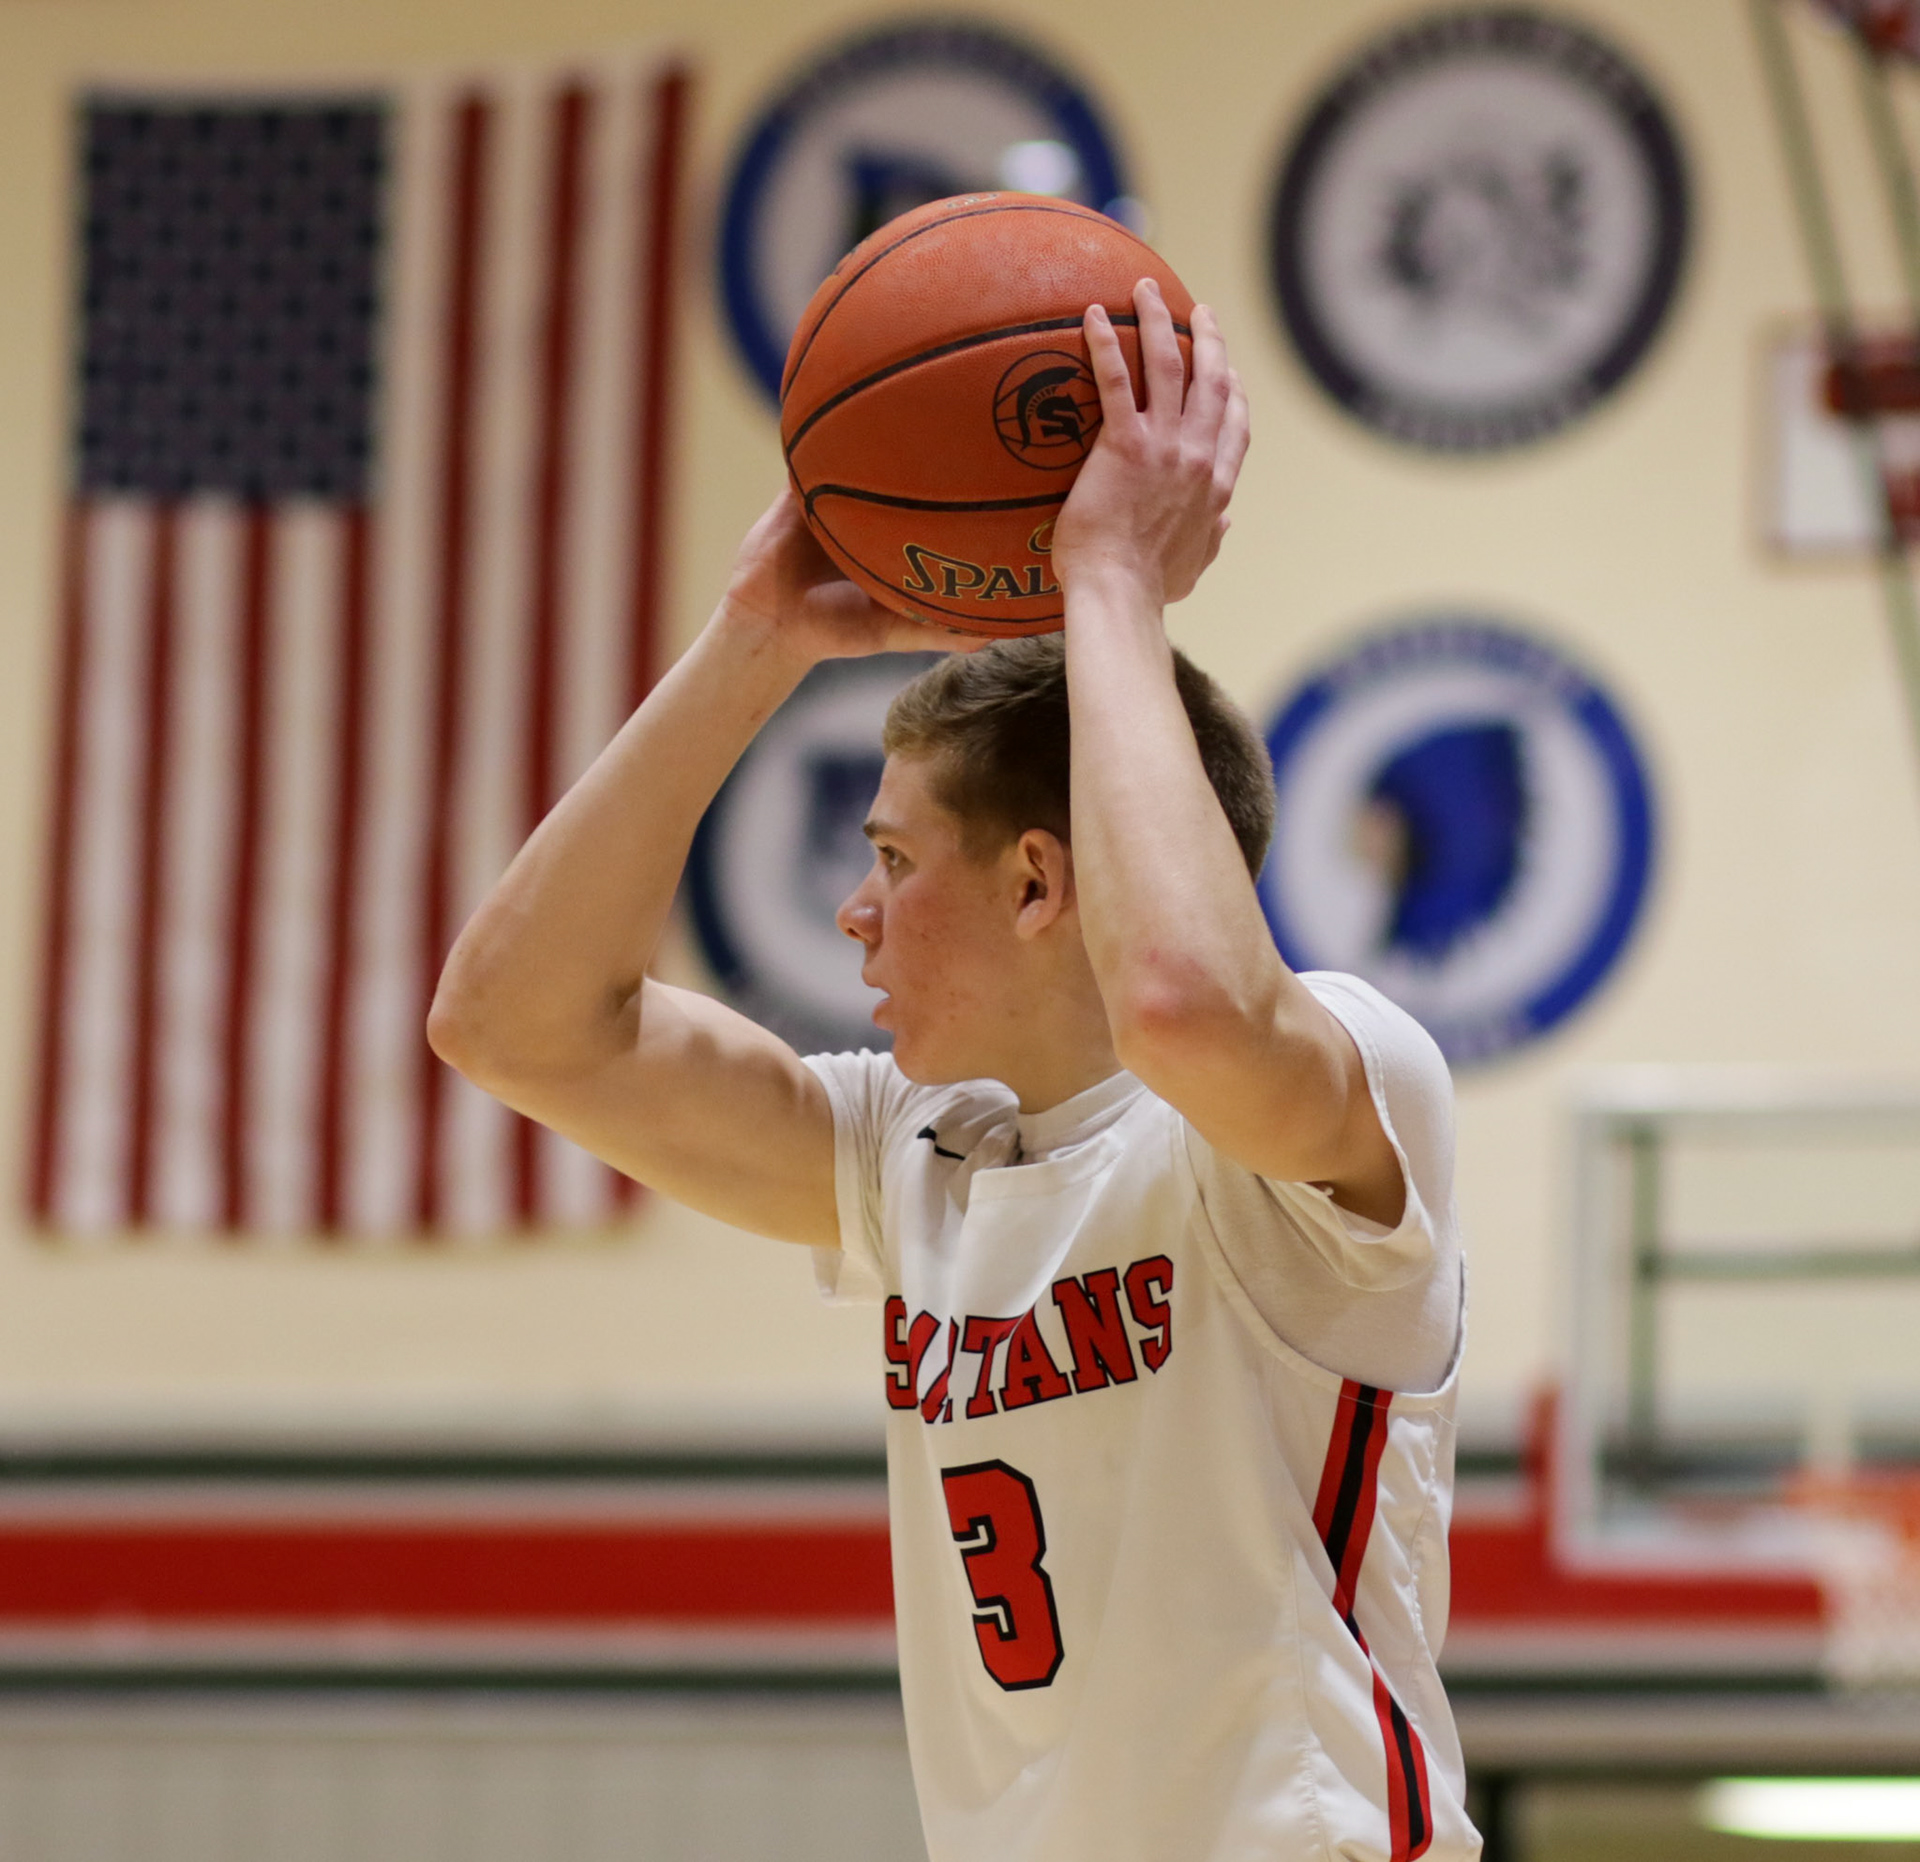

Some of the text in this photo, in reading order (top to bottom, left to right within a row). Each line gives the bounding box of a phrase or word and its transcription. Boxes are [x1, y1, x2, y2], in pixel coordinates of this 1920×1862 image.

[903, 543, 1060, 600] SPAL
[885, 1254, 1174, 1424] STANS
[941, 1458, 1065, 1692] 3
